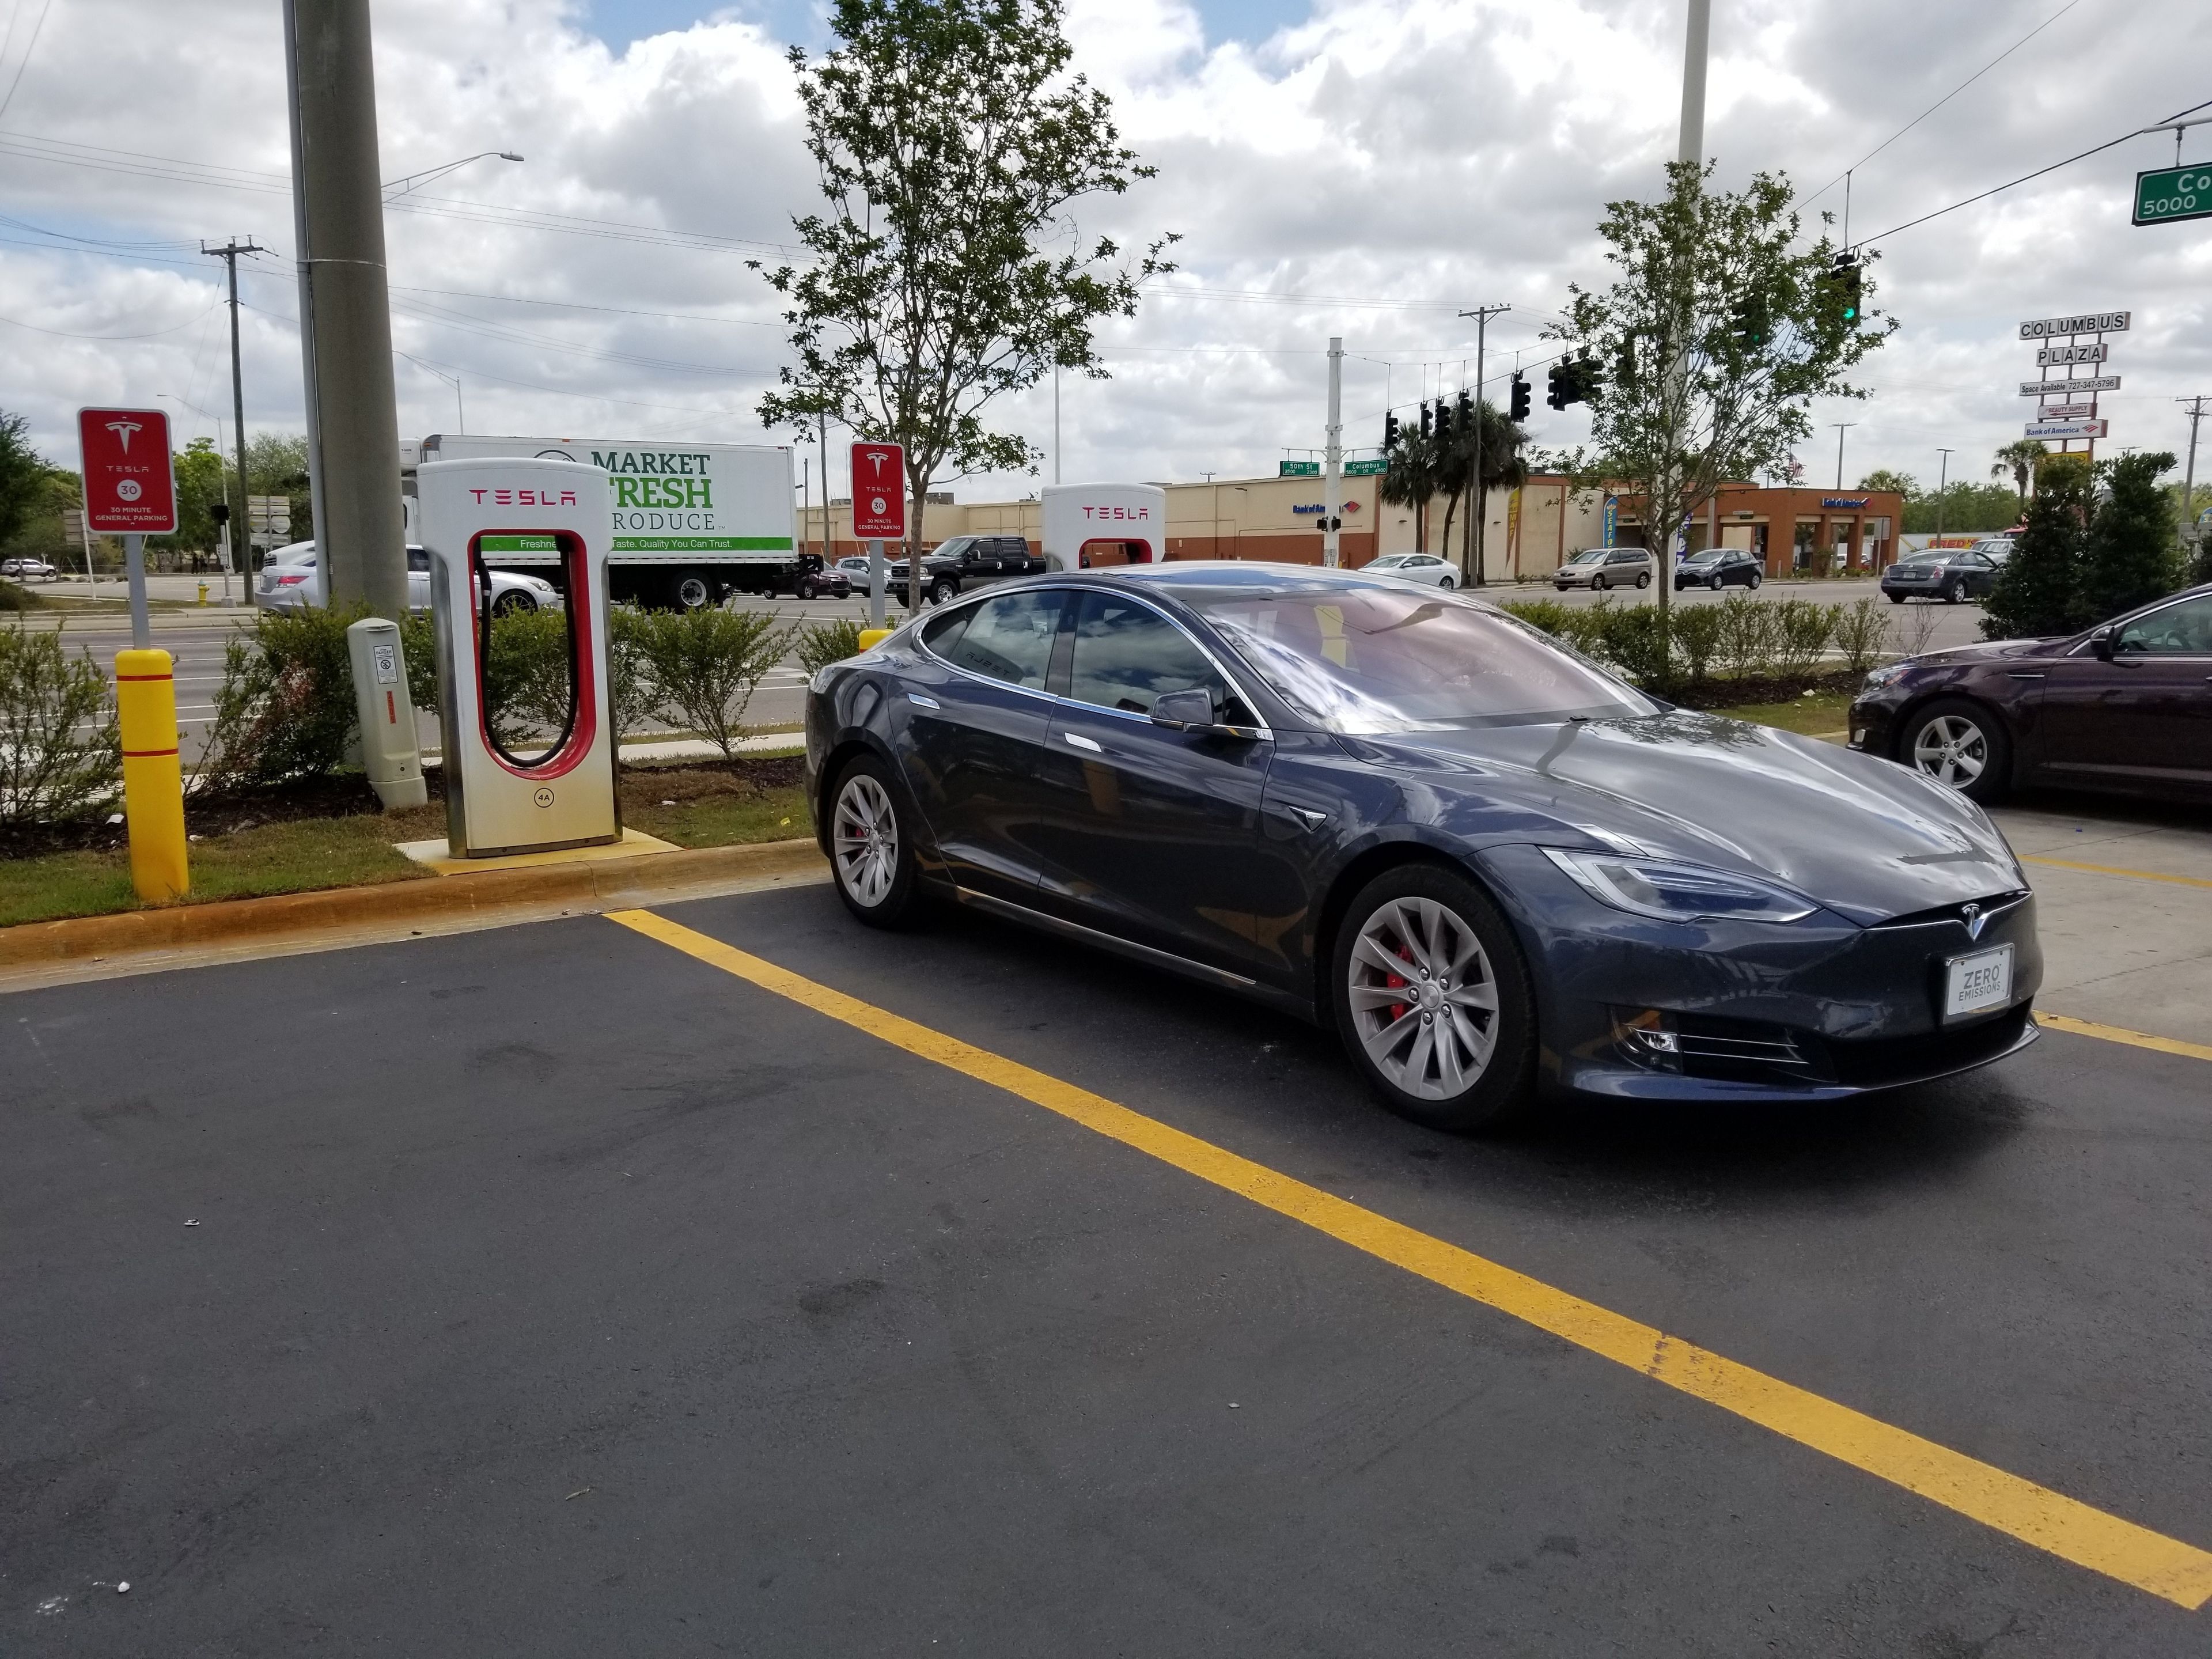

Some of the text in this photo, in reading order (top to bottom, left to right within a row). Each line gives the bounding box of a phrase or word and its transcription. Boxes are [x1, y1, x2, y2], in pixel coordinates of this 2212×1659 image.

[2177, 173, 2211, 193] Co
[2143, 195, 2196, 215] 5000
[2021, 315, 2124, 336] COLUMBUS
[2038, 347, 2101, 363] PLAZA
[2021, 379, 2115, 394] Space Available 727-347-5796
[2051, 426, 2080, 434] America
[590, 451, 711, 475] MARKET
[121, 486, 138, 494] 30
[468, 490, 576, 506] TESLA
[609, 477, 713, 509] RESH
[612, 513, 715, 531] RODUCE
[1082, 507, 1148, 520] TESLA
[520, 539, 733, 550] Freshne Taste. Quality You Can Trust.
[1963, 965, 1999, 990] ZERO
[1959, 981, 2001, 1001] EMISSIONS
